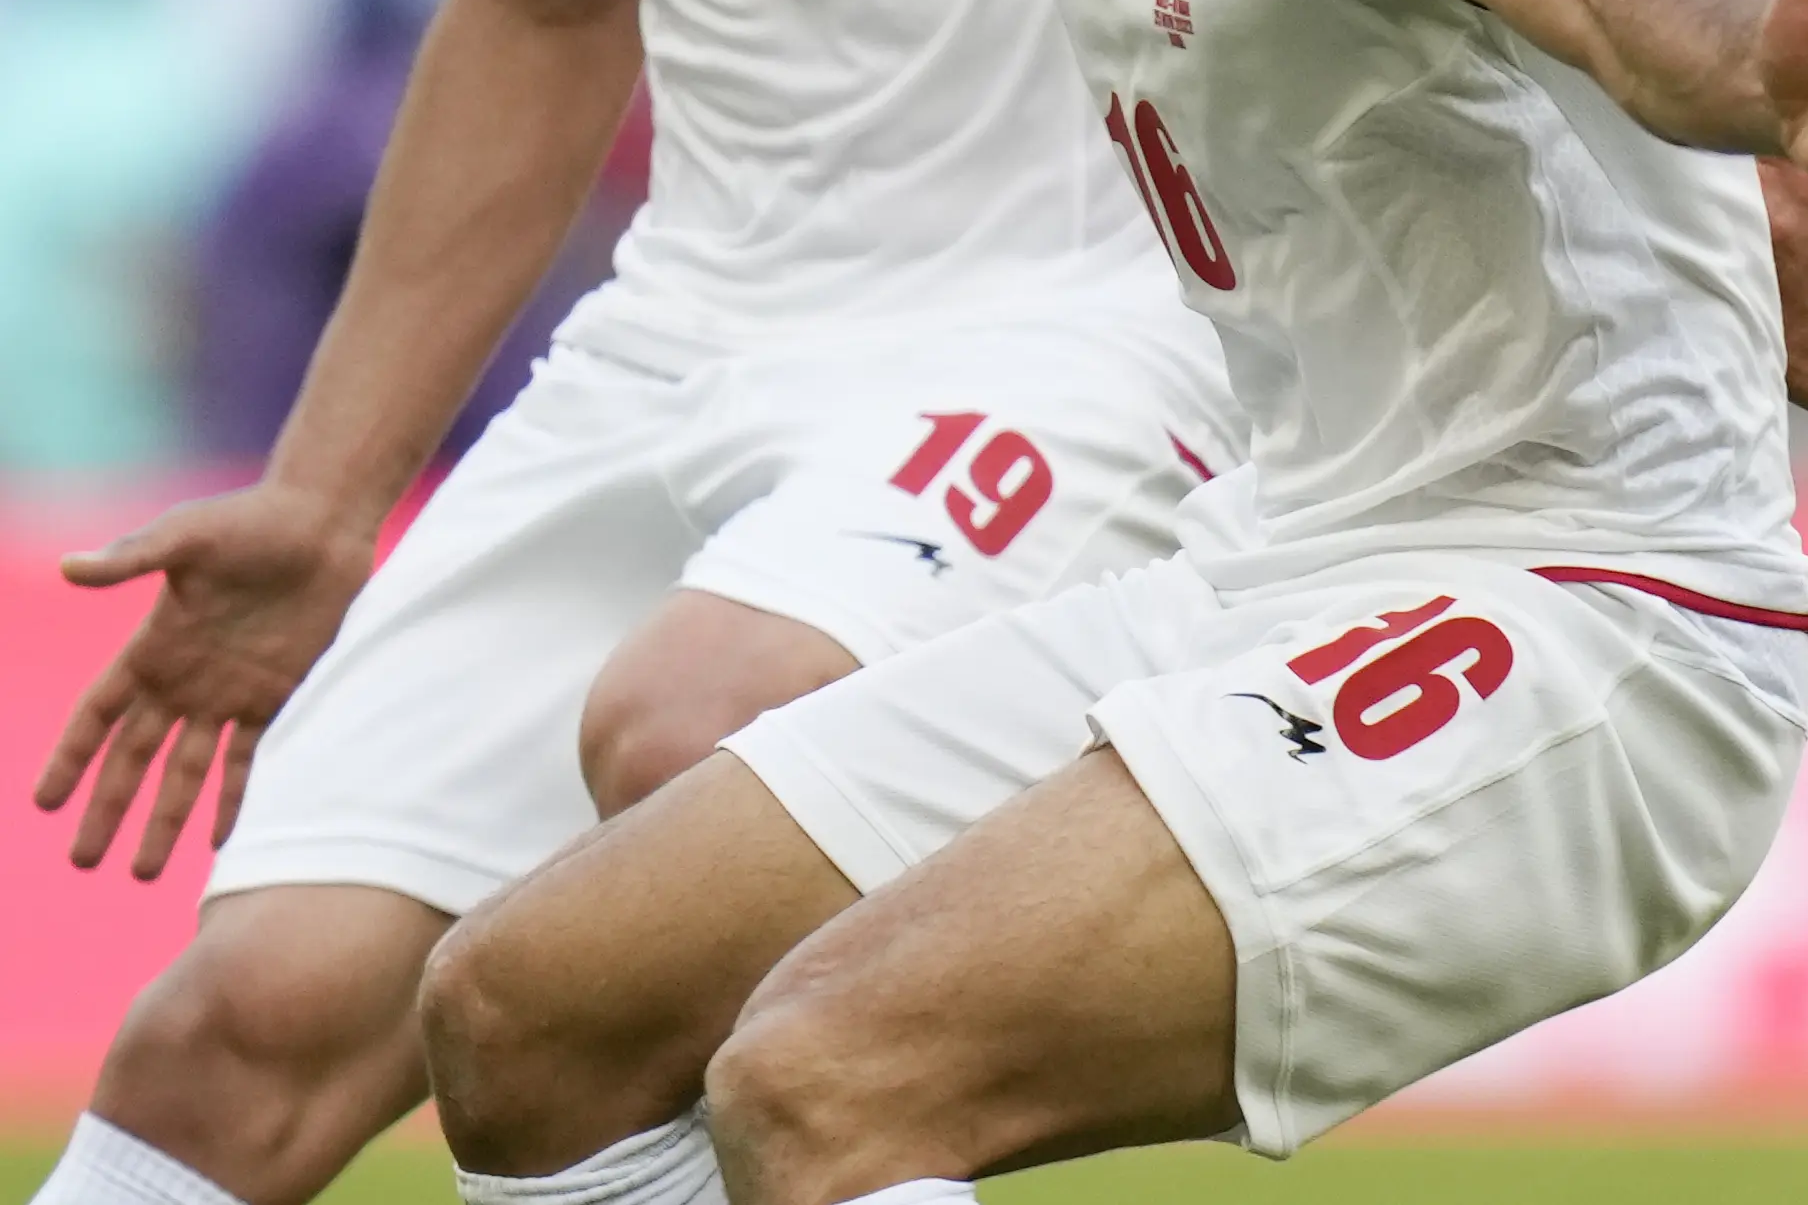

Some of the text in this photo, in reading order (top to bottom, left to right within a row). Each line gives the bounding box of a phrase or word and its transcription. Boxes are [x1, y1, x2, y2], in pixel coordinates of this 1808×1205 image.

[1104, 90, 1237, 291] 16
[886, 409, 1054, 559] 19
[1286, 595, 1514, 761] 16
